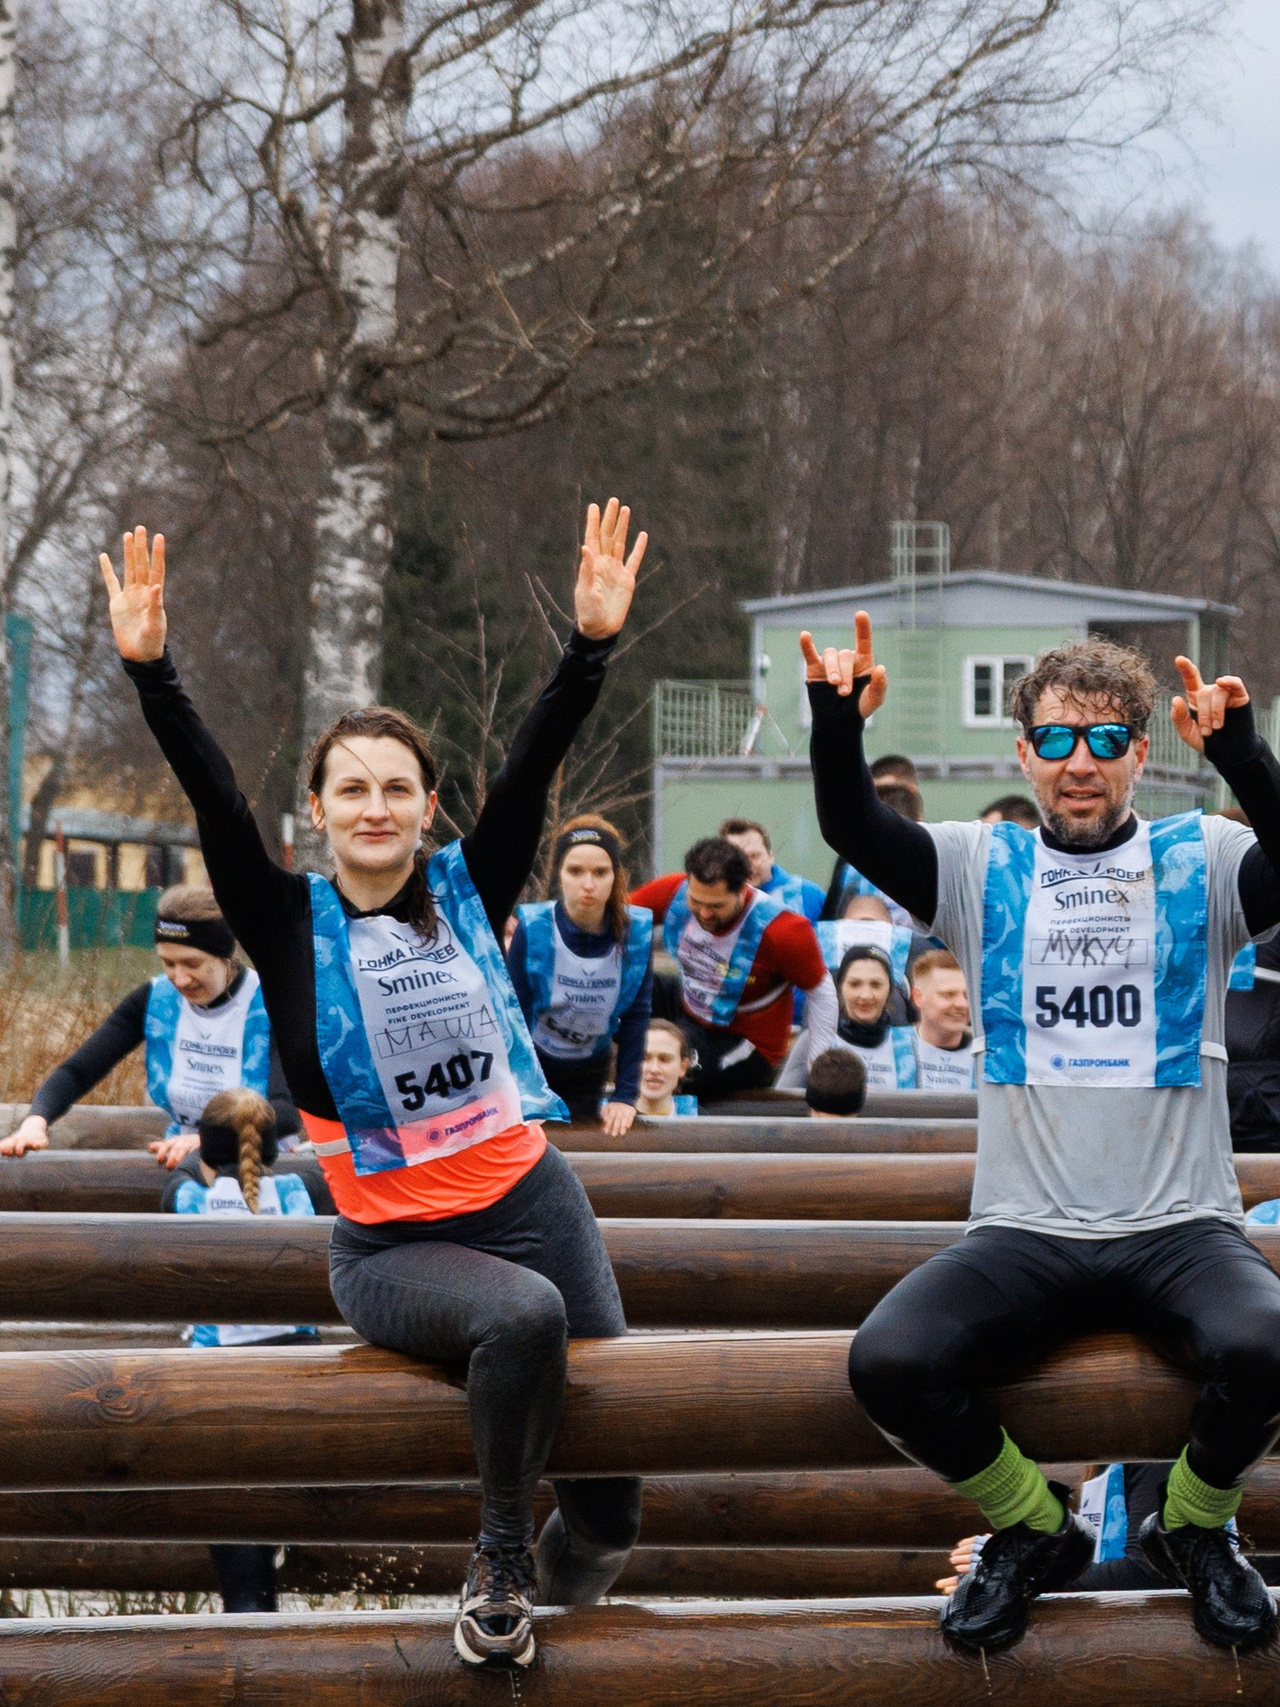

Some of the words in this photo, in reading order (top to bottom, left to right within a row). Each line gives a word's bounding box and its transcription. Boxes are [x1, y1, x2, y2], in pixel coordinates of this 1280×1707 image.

[1041, 868, 1077, 884] ГОНК
[1106, 867, 1146, 880] РОЕВ
[1054, 886, 1130, 911] Sminex
[1050, 914, 1131, 926] ПЕРФЕКЦИОНИСТЫ
[1070, 925, 1131, 934] DEVELOPMENT
[358, 946, 407, 968] ГОНКА
[377, 969, 459, 997] Sminex
[385, 991, 468, 1015] ПЕРФЕКЦИОНИСТЫ
[388, 1013, 408, 1025] FINE
[410, 1001, 471, 1021] DEVELOPMENT
[1035, 984, 1141, 1028] 5400
[384, 1004, 499, 1054] МАША
[1068, 1057, 1130, 1068] ГАЗПРОМБАНК
[394, 1050, 494, 1112] 5407
[444, 1105, 499, 1136] ГАЗПРОМБАНК
